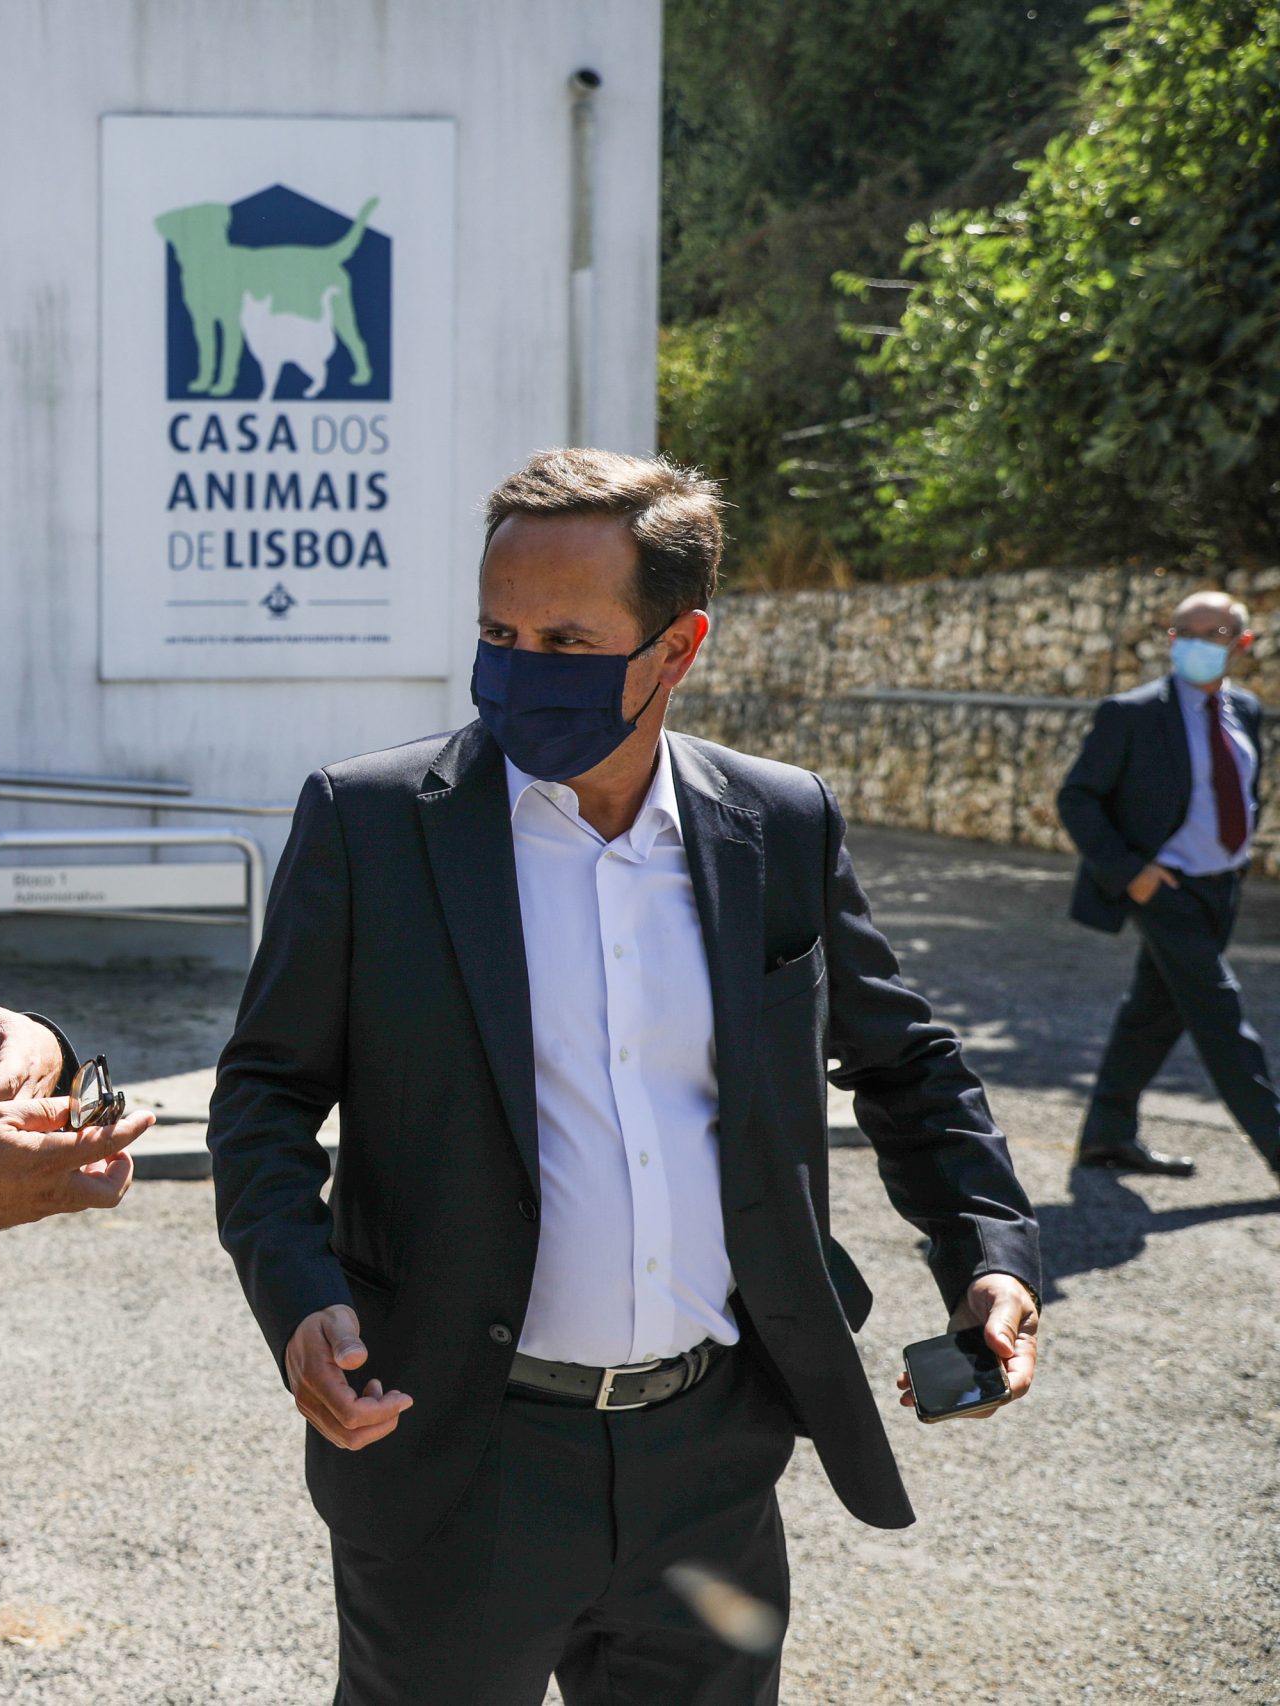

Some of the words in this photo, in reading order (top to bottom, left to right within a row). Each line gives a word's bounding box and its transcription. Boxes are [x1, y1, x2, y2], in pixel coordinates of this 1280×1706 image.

[167, 412, 298, 454] CASA
[311, 415, 389, 454] DOS
[166, 471, 389, 511] ANIMAIS
[224, 528, 389, 569] LISBOA
[13, 873, 53, 887] Bloco
